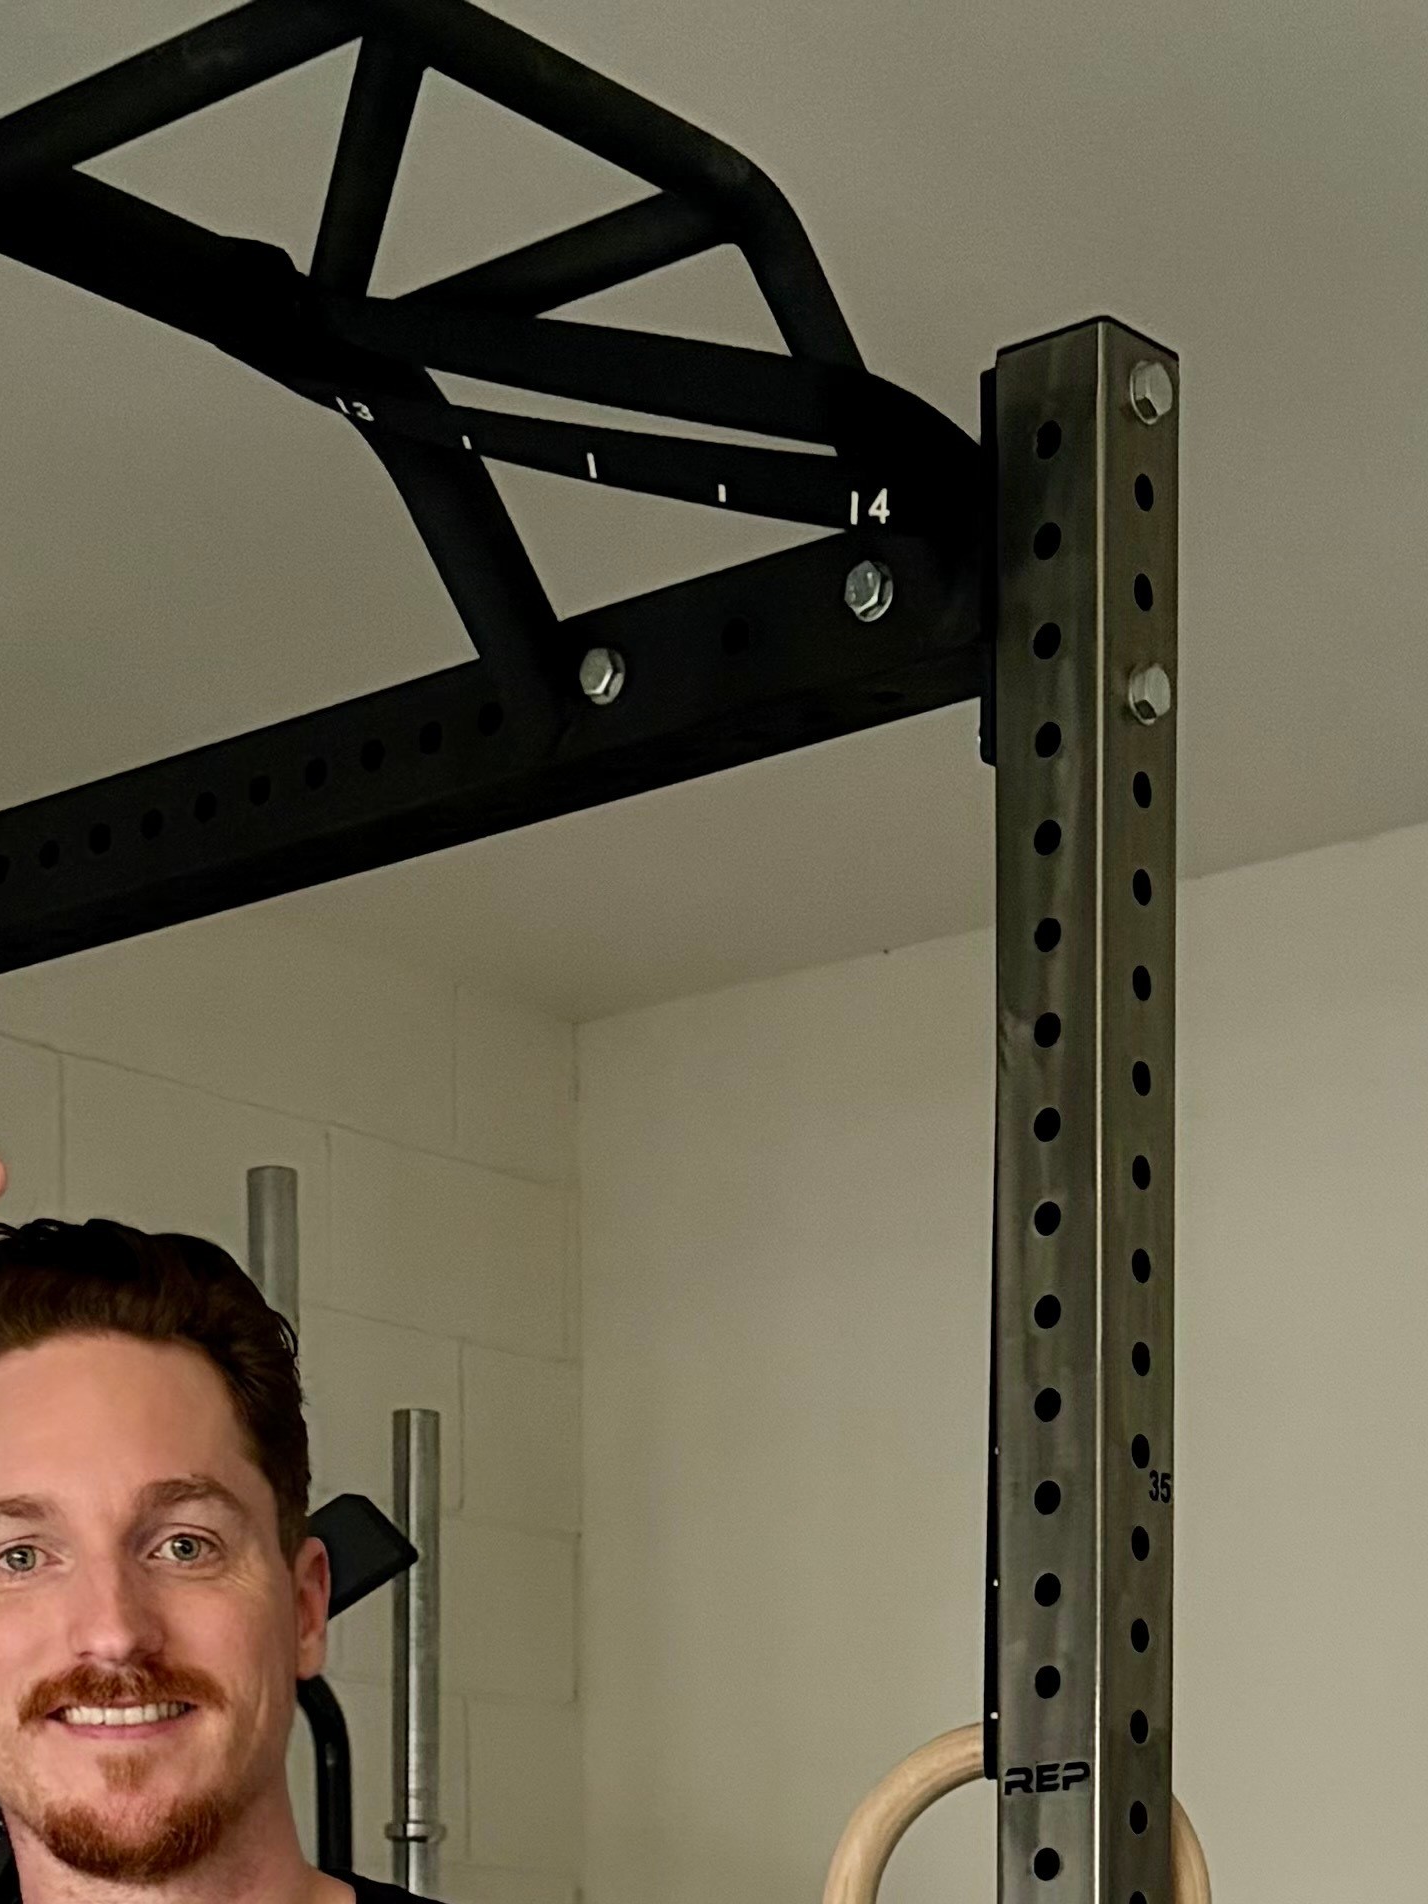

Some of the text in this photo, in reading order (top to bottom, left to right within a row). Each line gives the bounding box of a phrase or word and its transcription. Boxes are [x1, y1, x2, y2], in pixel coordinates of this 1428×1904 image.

[850, 487, 890, 526] 14
[1148, 1469, 1172, 1504] 35
[1003, 1761, 1091, 1796] REP
